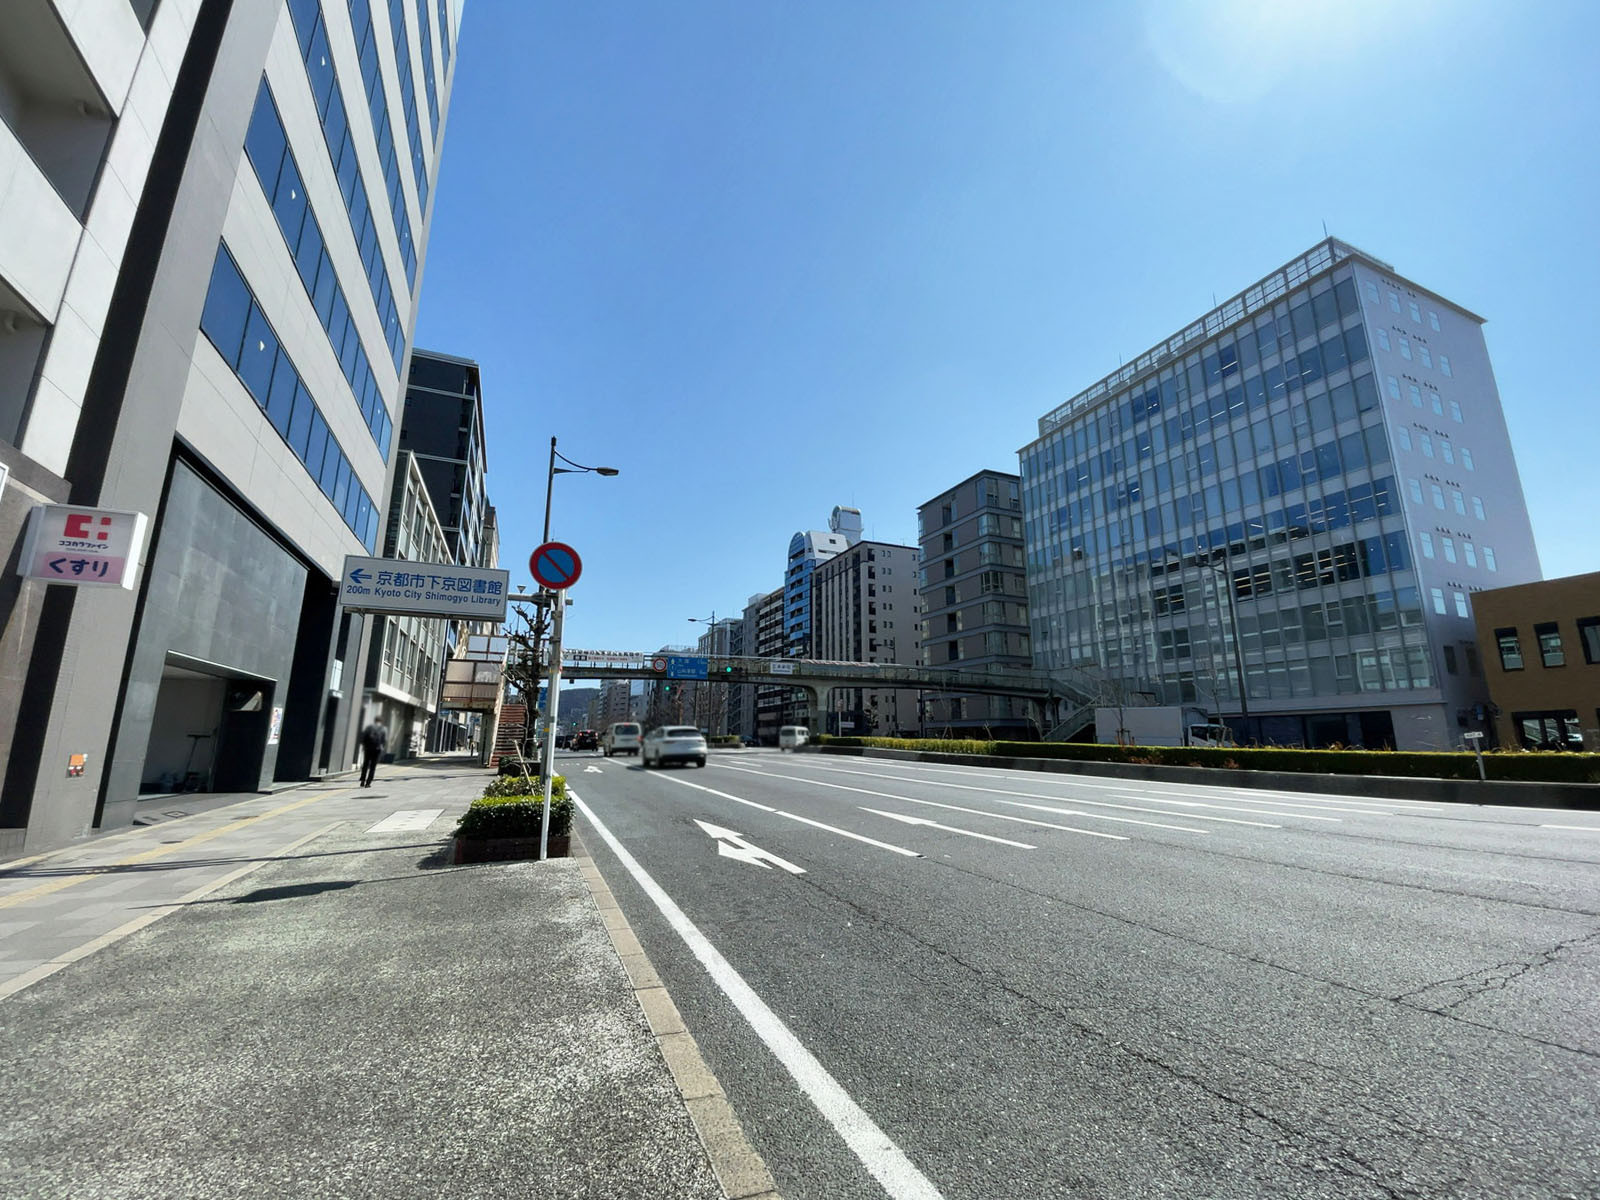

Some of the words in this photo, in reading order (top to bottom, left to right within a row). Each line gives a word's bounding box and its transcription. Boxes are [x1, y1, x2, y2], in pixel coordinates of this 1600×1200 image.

[58, 540, 109, 549] ココカラファイン
[49, 558, 109, 577] くすり
[376, 571, 503, 595] 京都市下京図書館
[346, 585, 371, 595] 200m
[374, 587, 401, 598] Kyoto
[404, 590, 422, 601] City
[425, 591, 468, 604] Shimogyo
[471, 595, 501, 607] Library
